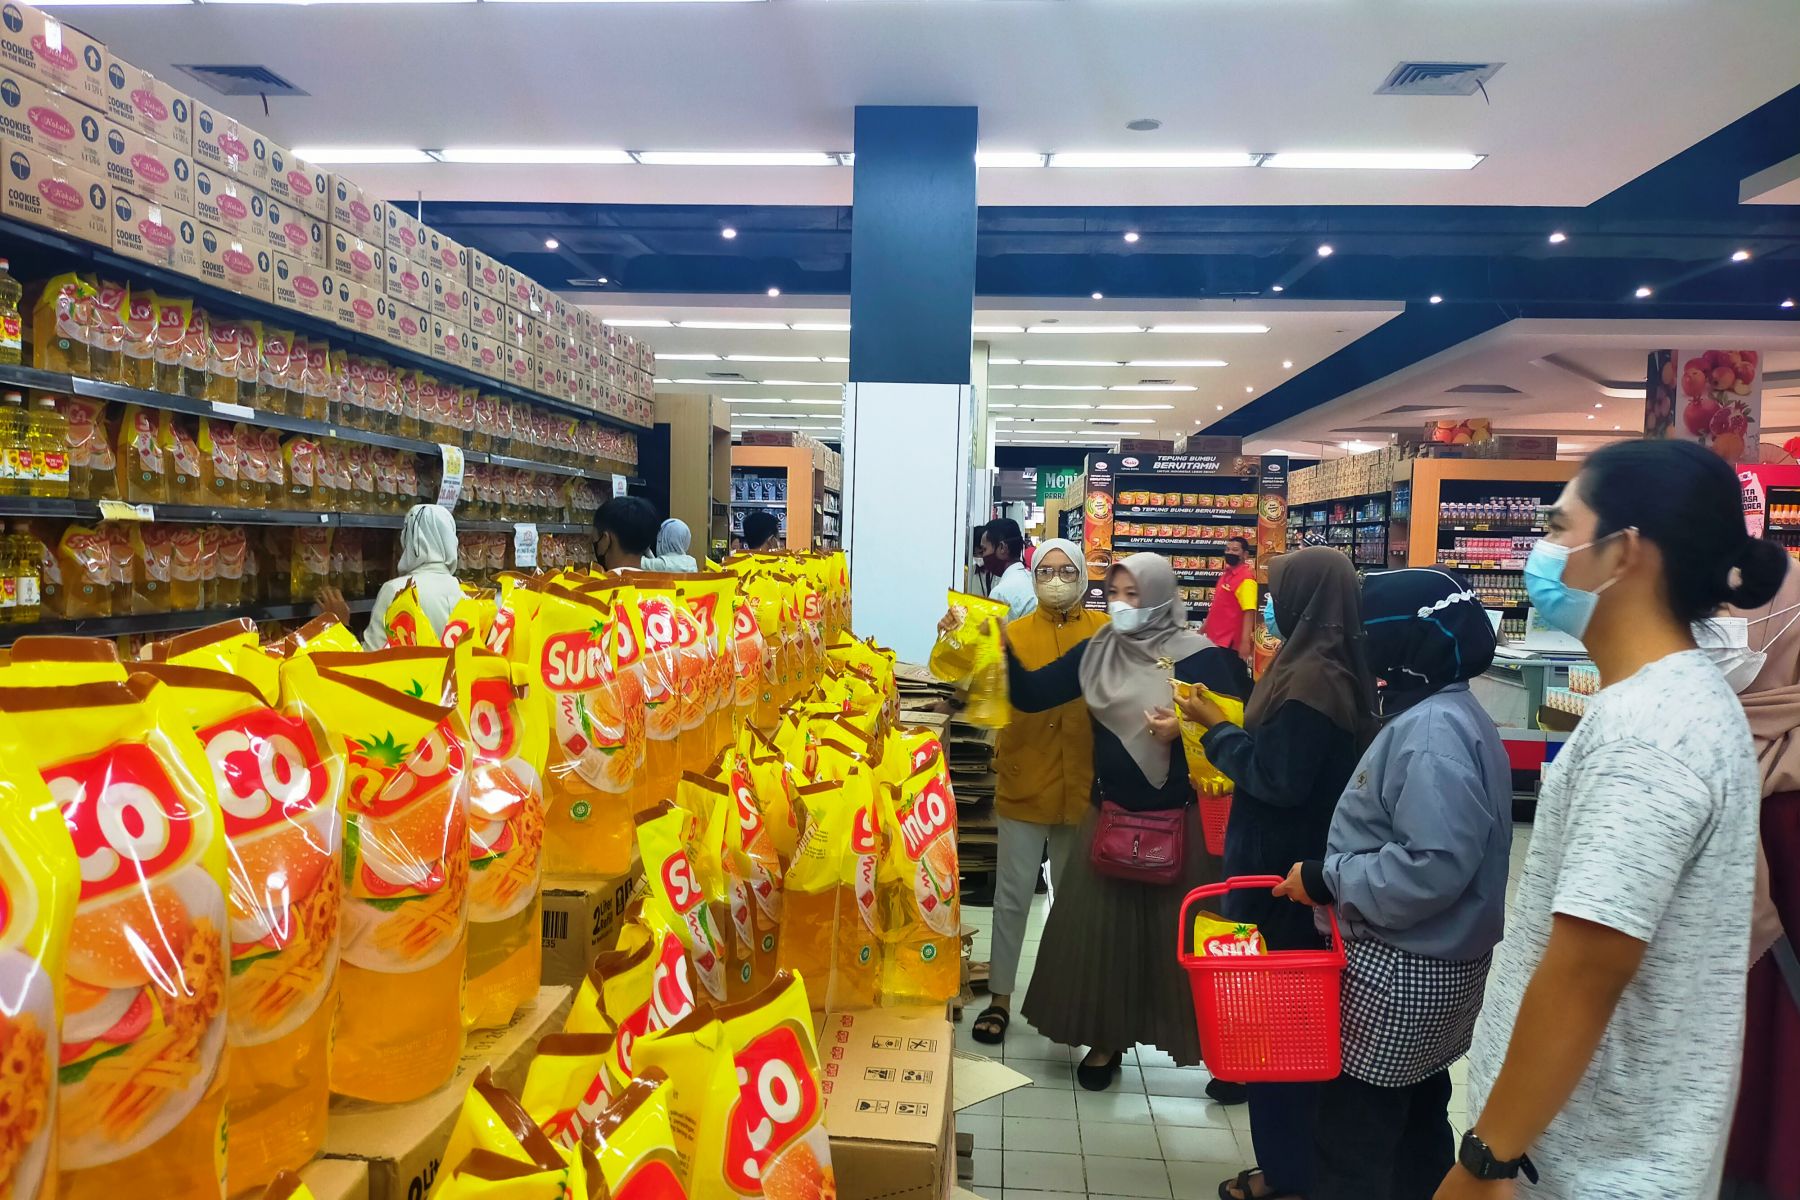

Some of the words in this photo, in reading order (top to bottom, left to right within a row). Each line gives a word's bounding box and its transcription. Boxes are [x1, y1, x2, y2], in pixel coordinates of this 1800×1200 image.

[1, 40, 34, 60] COOKIES
[108, 95, 133, 114] COOKIES
[0, 116, 31, 134] COOKIES
[107, 161, 134, 178] COOKIES
[8, 188, 40, 206] COOKIES
[116, 228, 142, 244] COOKIES
[202, 260, 224, 274] COOKIES
[1153, 462, 1220, 470] BERVITAMIN
